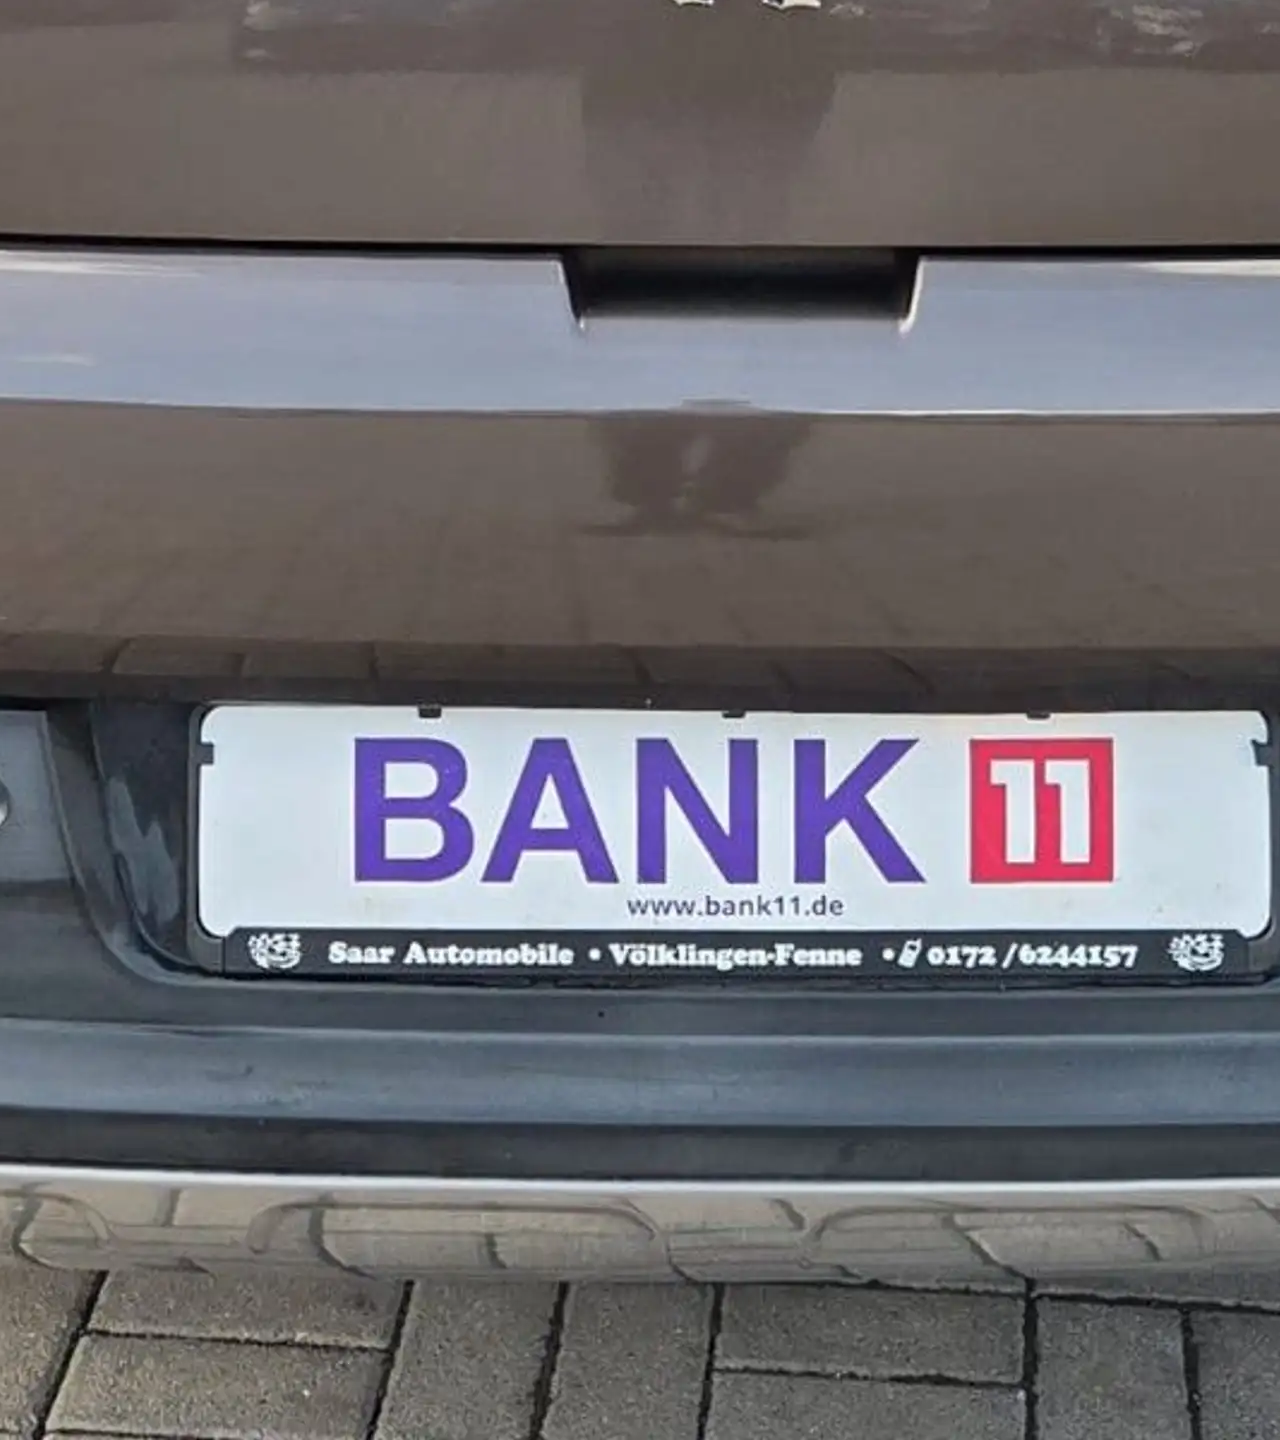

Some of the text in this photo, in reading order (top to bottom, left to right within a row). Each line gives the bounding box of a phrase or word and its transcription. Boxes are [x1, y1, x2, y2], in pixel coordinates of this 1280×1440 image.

[353, 737, 1089, 884] BANK 11
[626, 894, 845, 917] www.bank11.de
[328, 941, 396, 965] Saar
[403, 941, 576, 967] Automobile
[926, 946, 998, 969] 0172
